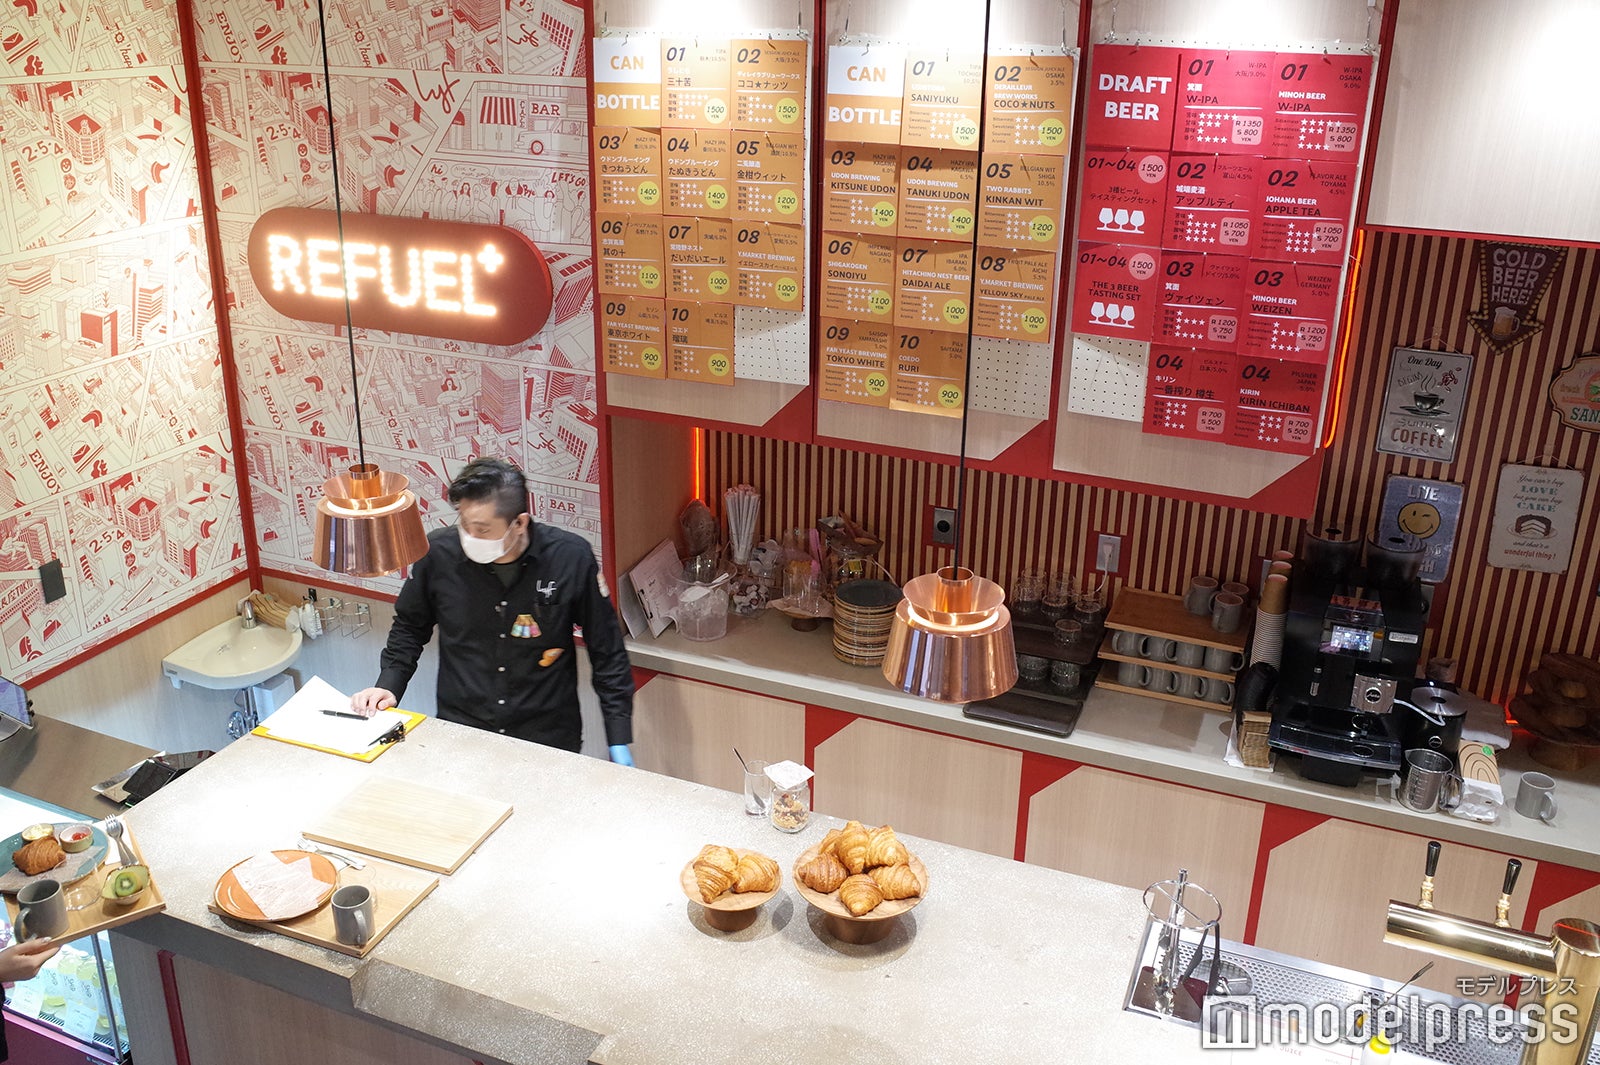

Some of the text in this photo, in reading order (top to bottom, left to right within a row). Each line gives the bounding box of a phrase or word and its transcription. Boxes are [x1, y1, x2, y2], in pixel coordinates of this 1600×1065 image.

[216, 10, 244, 63] ENJOY
[666, 47, 686, 62] 01
[737, 48, 761, 64] 02
[610, 55, 645, 70] CAN
[912, 60, 935, 77] 01
[1188, 58, 1214, 77] 01
[846, 65, 886, 82] CAN
[994, 65, 1021, 82] 02
[1281, 63, 1308, 81] 01
[1098, 73, 1172, 96] DRAFT
[1186, 95, 1219, 105] W-IPA
[1278, 91, 1326, 100] MINOH BEER
[596, 93, 661, 111] BOTTLE
[1278, 102, 1311, 111] W-IPA
[531, 102, 561, 116] BAR
[706, 105, 725, 114] 1500
[778, 105, 797, 115] 1500
[1104, 101, 1159, 123] BEER
[828, 106, 901, 126] BOTTLE
[955, 126, 976, 136] 1500
[1041, 126, 1062, 135] 1500
[599, 135, 621, 150] 03
[667, 137, 689, 152] 04
[736, 140, 760, 156] 05
[831, 150, 855, 167] 03
[907, 155, 933, 172] 04
[430, 163, 444, 175] hi
[601, 164, 648, 175] きつねうどん
[669, 166, 716, 178] たぬきうどん
[986, 162, 1013, 179] 05
[1141, 163, 1163, 173] 1500
[1177, 162, 1206, 179] 02
[831, 172, 881, 182] UDON BREWING
[906, 177, 958, 189] UDON BREWING
[1267, 169, 1299, 187] 02
[639, 187, 657, 196] 1400
[831, 182, 897, 195] KITSUNE UDON
[906, 187, 970, 202] TANUKI UDON
[985, 185, 1032, 195] TWO RABBITS
[707, 190, 726, 200] 1400
[776, 196, 796, 205] 1200
[985, 195, 1044, 207] KINKAN WIT
[1090, 193, 1157, 205] テイスティングセット
[1266, 195, 1297, 204] JOHANA
[1175, 195, 1235, 208] アップルティ
[874, 208, 894, 218] 1400
[1265, 205, 1321, 216] APPLE TEA
[951, 215, 972, 225] 1400
[1032, 223, 1053, 232] 1200
[671, 253, 727, 265] だいだいエール
[828, 260, 867, 270] SHIGAKOGEN
[1493, 248, 1547, 270] COLD
[1131, 260, 1153, 271] 1500
[1166, 261, 1194, 278] 03
[641, 272, 659, 281] 1100
[828, 269, 867, 281] SONOJYU
[1254, 269, 1284, 287] 03
[1492, 266, 1540, 289] BEER
[710, 277, 728, 287] 1000
[902, 278, 951, 291] DAIDAI ALE
[1013, 281, 1044, 291] BREWING
[1091, 280, 1139, 292] THE 3 BEER
[1300, 282, 1331, 290] GERMANY
[777, 284, 796, 293] 1000
[980, 289, 1008, 297] YELLOW
[1009, 291, 1023, 299] SKY
[870, 296, 889, 306] 1100
[1087, 289, 1142, 302] TASTING SET
[1164, 293, 1225, 306] ヴァイツェン
[1252, 295, 1297, 305] MINOH BEER
[1491, 285, 1533, 305] HERE!
[672, 307, 689, 322] 10
[945, 306, 965, 316] 1000
[1251, 304, 1292, 315] WEIZEN
[1024, 315, 1044, 324] 1000
[607, 329, 650, 341] 東京ホワイト
[900, 334, 920, 350] 10
[644, 353, 658, 362] 900
[711, 359, 727, 368] 900
[826, 354, 885, 368] TOKYO WHITE
[899, 354, 920, 363] COEDO
[1156, 354, 1184, 371] 04
[1407, 355, 1443, 370] One Day
[898, 364, 920, 373] RURI
[1241, 364, 1271, 382] 04
[868, 378, 885, 388] 900
[1155, 375, 1177, 383] キリン
[941, 390, 959, 400] 900
[1240, 388, 1260, 396] KIRIN
[260, 384, 285, 431] ENJOY
[1239, 397, 1310, 413] KIRIN ICHIBAN
[1570, 407, 1600, 423] SAN
[1390, 427, 1445, 449] COFFEE
[29, 448, 62, 496] ENJOY
[1521, 485, 1560, 496] LOVE
[549, 499, 577, 513] BAR
[1517, 502, 1556, 513] CAKE
[1504, 549, 1536, 558] wonderful
